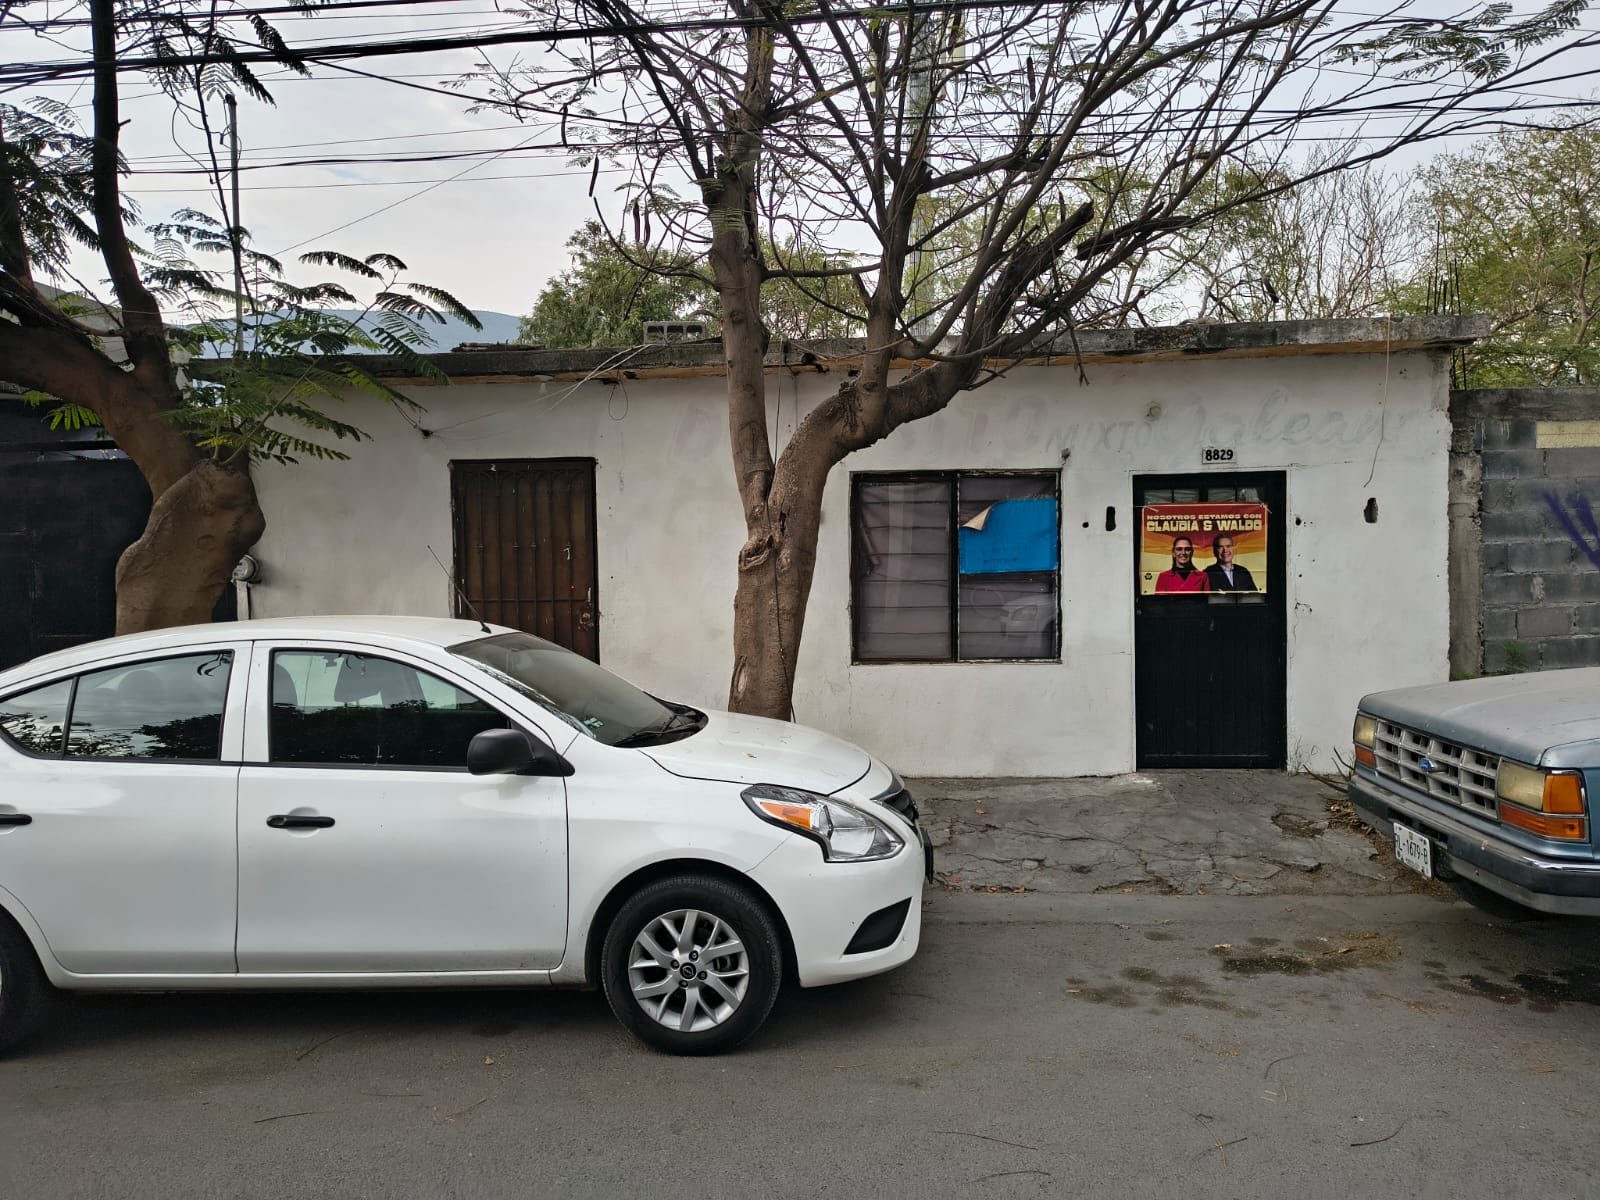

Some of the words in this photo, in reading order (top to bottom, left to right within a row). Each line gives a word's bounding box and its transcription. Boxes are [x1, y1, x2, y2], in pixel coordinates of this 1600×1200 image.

[1205, 449, 1234, 461] 8829
[1146, 520, 1200, 532] CLAUDIA
[1216, 520, 1262, 531] WALDO
